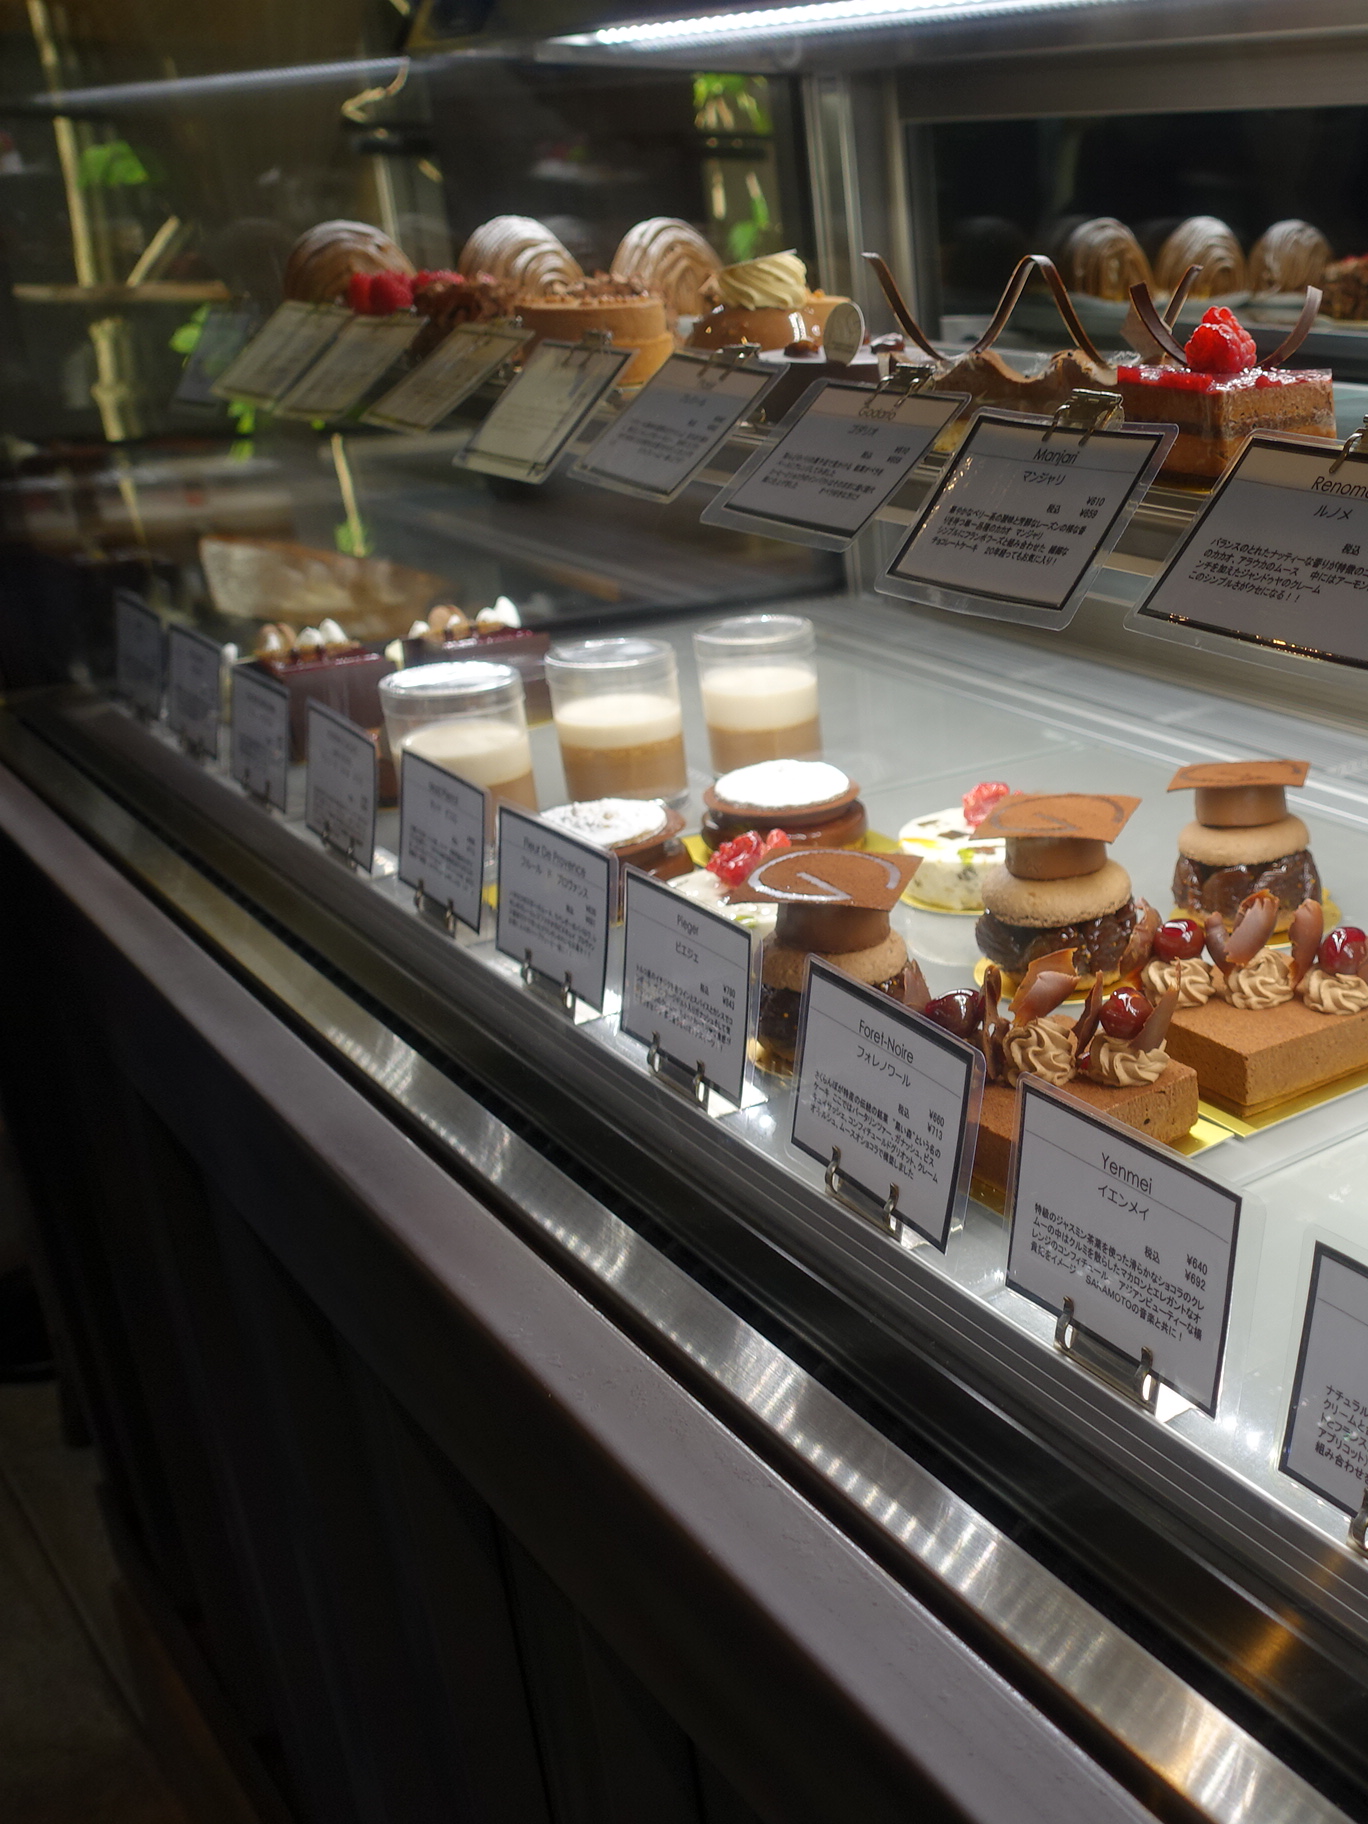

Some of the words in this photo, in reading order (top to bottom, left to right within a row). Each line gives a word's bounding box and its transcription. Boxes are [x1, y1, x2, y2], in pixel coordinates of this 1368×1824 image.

[1032, 447, 1080, 466] Manjari
[1023, 470, 1066, 486] マンジャリ
[1313, 504, 1353, 520] ルノメ
[1341, 543, 1361, 556] 税込
[858, 1018, 914, 1064] Foret-Noire
[856, 1045, 911, 1087] フォレノワール
[929, 1109, 945, 1127] ¥660
[927, 1122, 943, 1141] ¥713
[1101, 1152, 1152, 1195] Yenmei
[1097, 1184, 1149, 1221] イエンメイ
[1144, 1245, 1160, 1264] 税込
[1184, 1268, 1206, 1291] ¥692
[1186, 1253, 1208, 1276] ¥640
